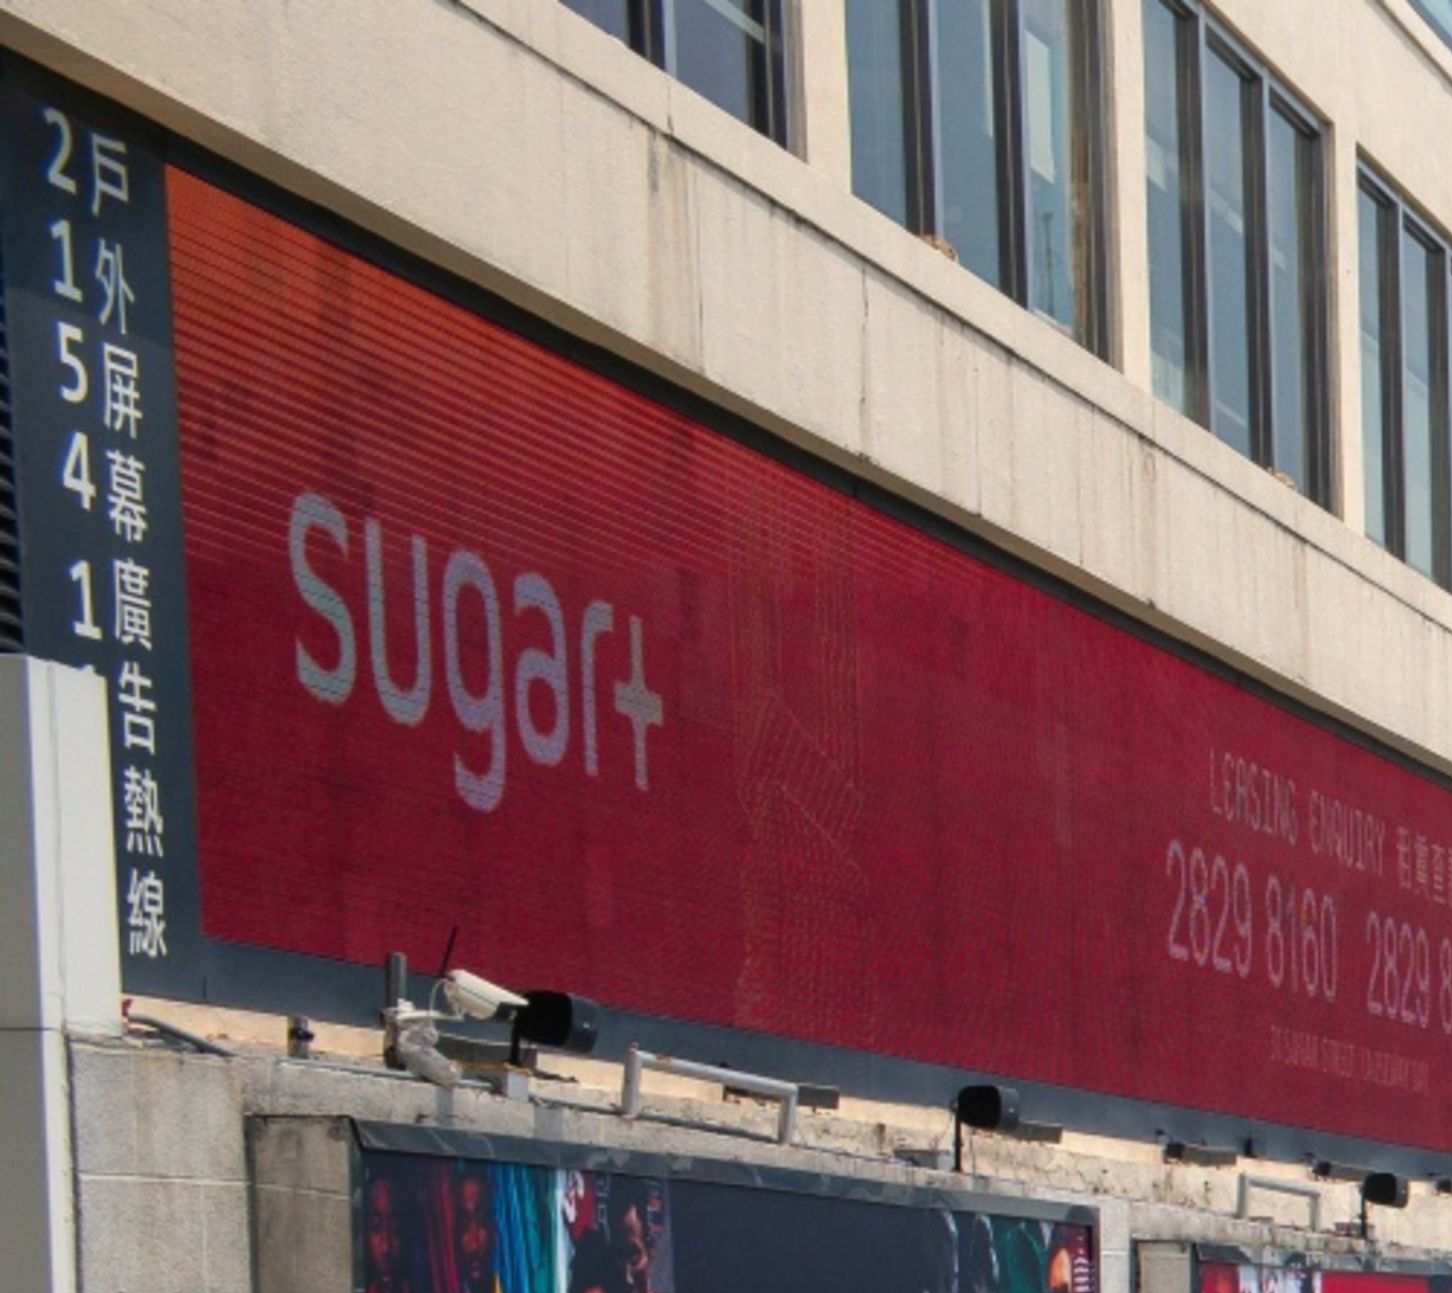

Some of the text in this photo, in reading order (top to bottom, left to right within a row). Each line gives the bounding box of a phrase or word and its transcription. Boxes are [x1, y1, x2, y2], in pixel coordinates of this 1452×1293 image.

[43, 106, 105, 677] 2154 1
[1208, 748, 1298, 847] LEASING
[1309, 788, 1386, 876] ENQUIRY
[1166, 840, 1338, 1004] 2829 8160
[1366, 912, 1431, 1030] 2829
